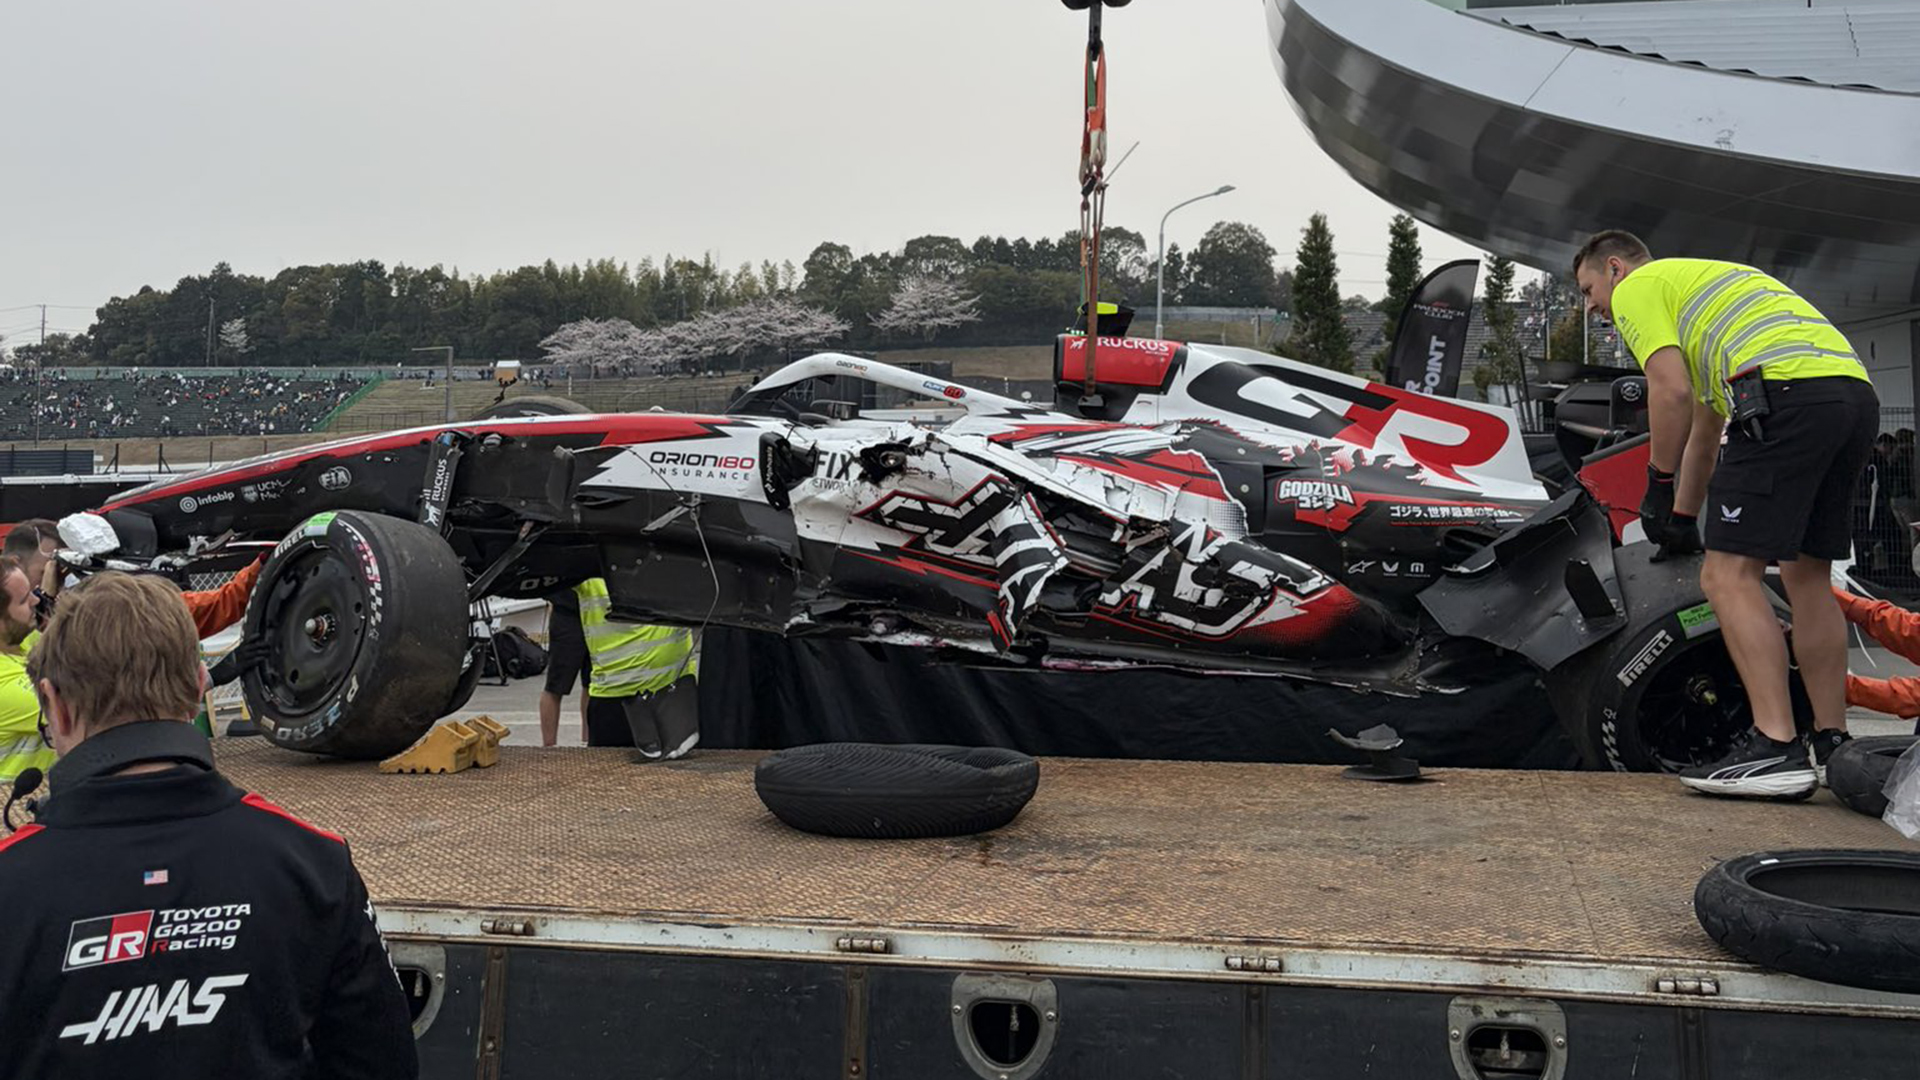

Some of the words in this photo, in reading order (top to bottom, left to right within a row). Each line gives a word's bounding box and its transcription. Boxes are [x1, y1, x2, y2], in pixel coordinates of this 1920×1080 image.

[1096, 336, 1169, 352] RUCKUS
[650, 451, 756, 470] ORION180
[320, 472, 350, 488] FIA
[431, 458, 448, 501] RUCKUS
[650, 467, 751, 481] INSURANCE
[1279, 480, 1355, 505] GODZILLA
[1616, 629, 1674, 688] PIRELLI
[159, 903, 251, 924] TOYOTA
[154, 919, 241, 939] GAZOO
[68, 930, 145, 966] GR
[151, 934, 238, 954] Racing
[59, 973, 250, 1046] HAAS
